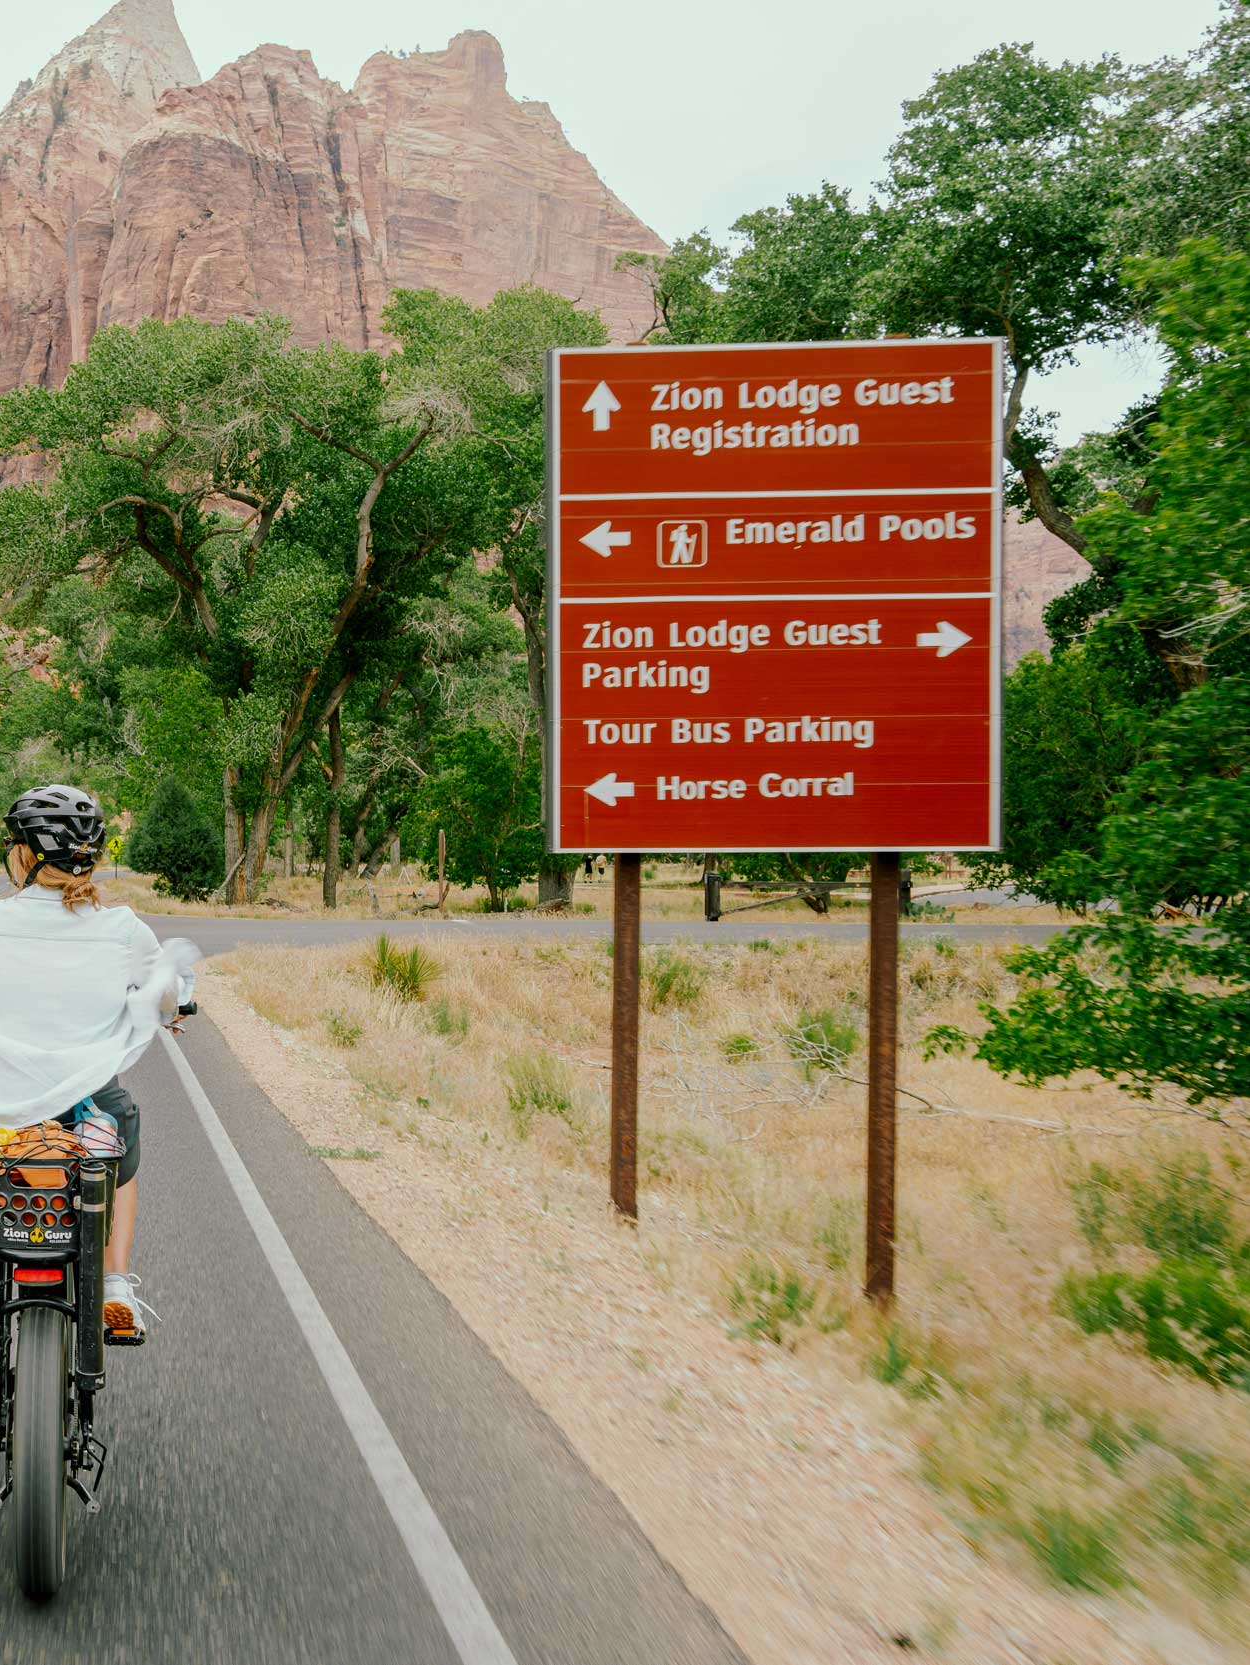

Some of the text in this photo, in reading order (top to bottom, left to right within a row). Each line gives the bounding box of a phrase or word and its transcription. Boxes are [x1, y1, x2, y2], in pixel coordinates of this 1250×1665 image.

[651, 377, 954, 414] Zion Lodge Guest
[651, 419, 859, 456] Registration
[726, 512, 976, 544] Emerald Pools
[583, 619, 881, 653] Zion Lodge Guest
[583, 660, 709, 693] Parking
[583, 716, 873, 748] Tour Bus Parking
[657, 772, 853, 800] Horse Corral
[4, 1228, 71, 1239] Zion Guru
